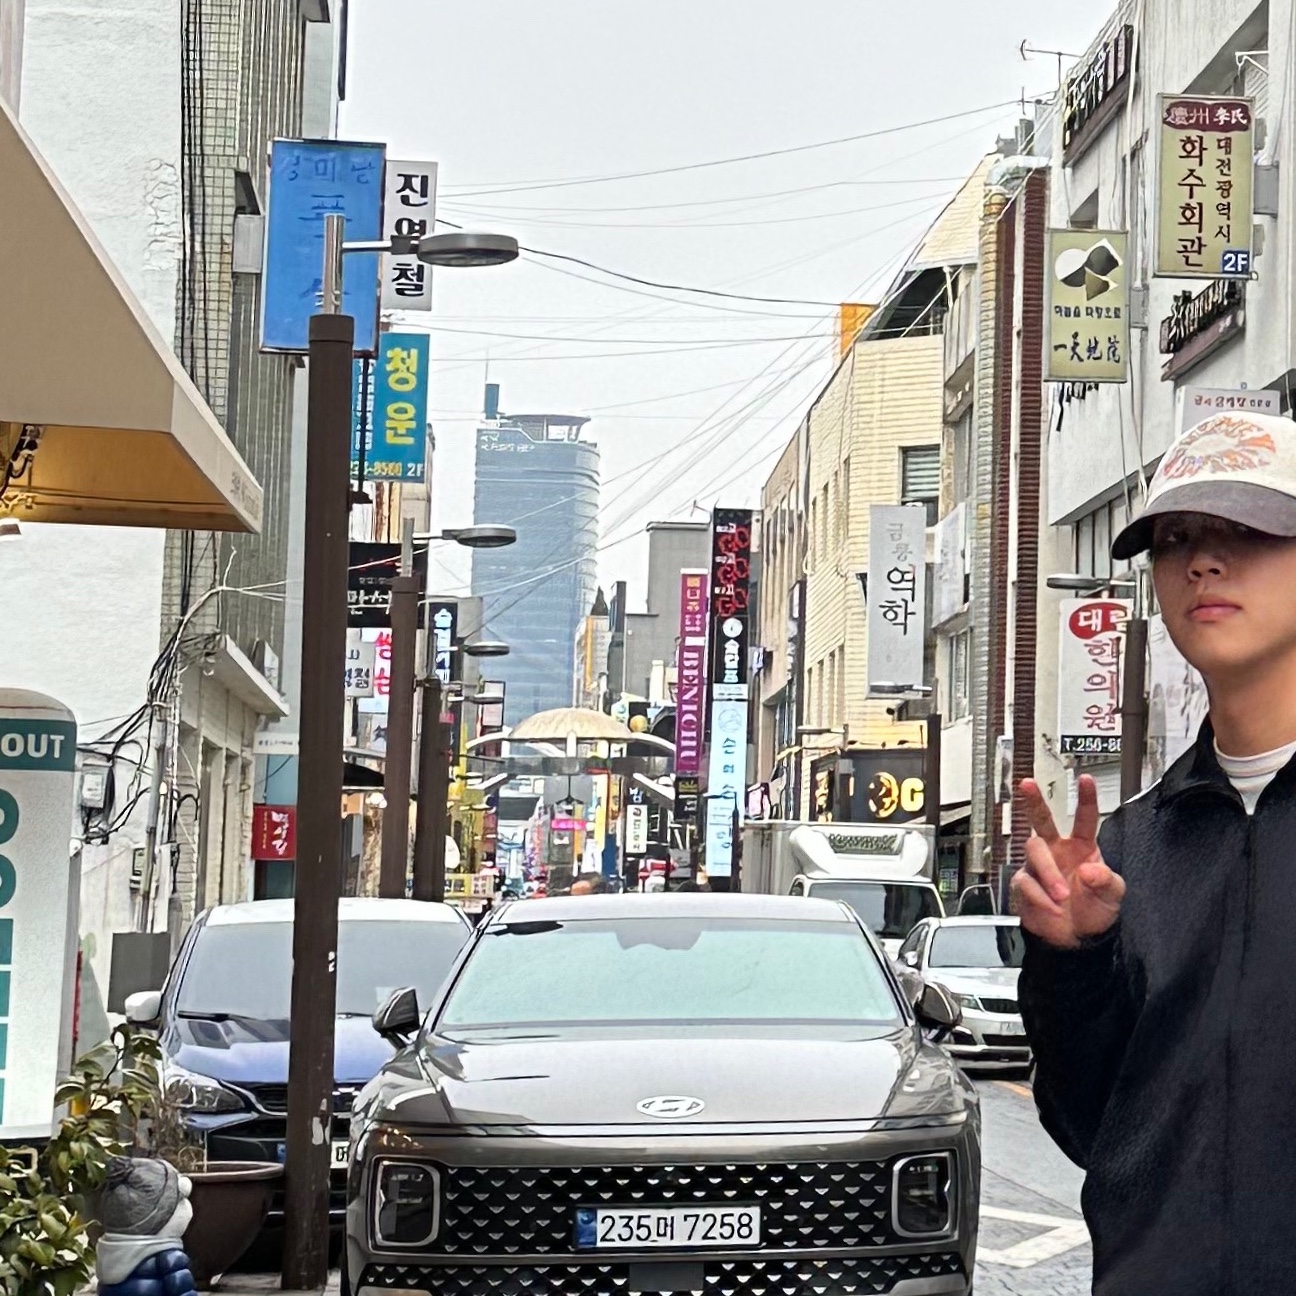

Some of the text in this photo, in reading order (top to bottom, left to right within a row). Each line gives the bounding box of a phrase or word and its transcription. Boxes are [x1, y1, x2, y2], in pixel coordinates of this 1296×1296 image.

[1177, 134, 1208, 268] 화수회관
[1214, 136, 1233, 244] 대전광역시
[1223, 252, 1248, 272] 2F
[385, 347, 419, 446] 청운
[878, 563, 917, 636] 역학
[1082, 635, 1122, 731] 한의원
[1, 733, 65, 760] OUT
[600, 1212, 754, 1242] 235머 7258
